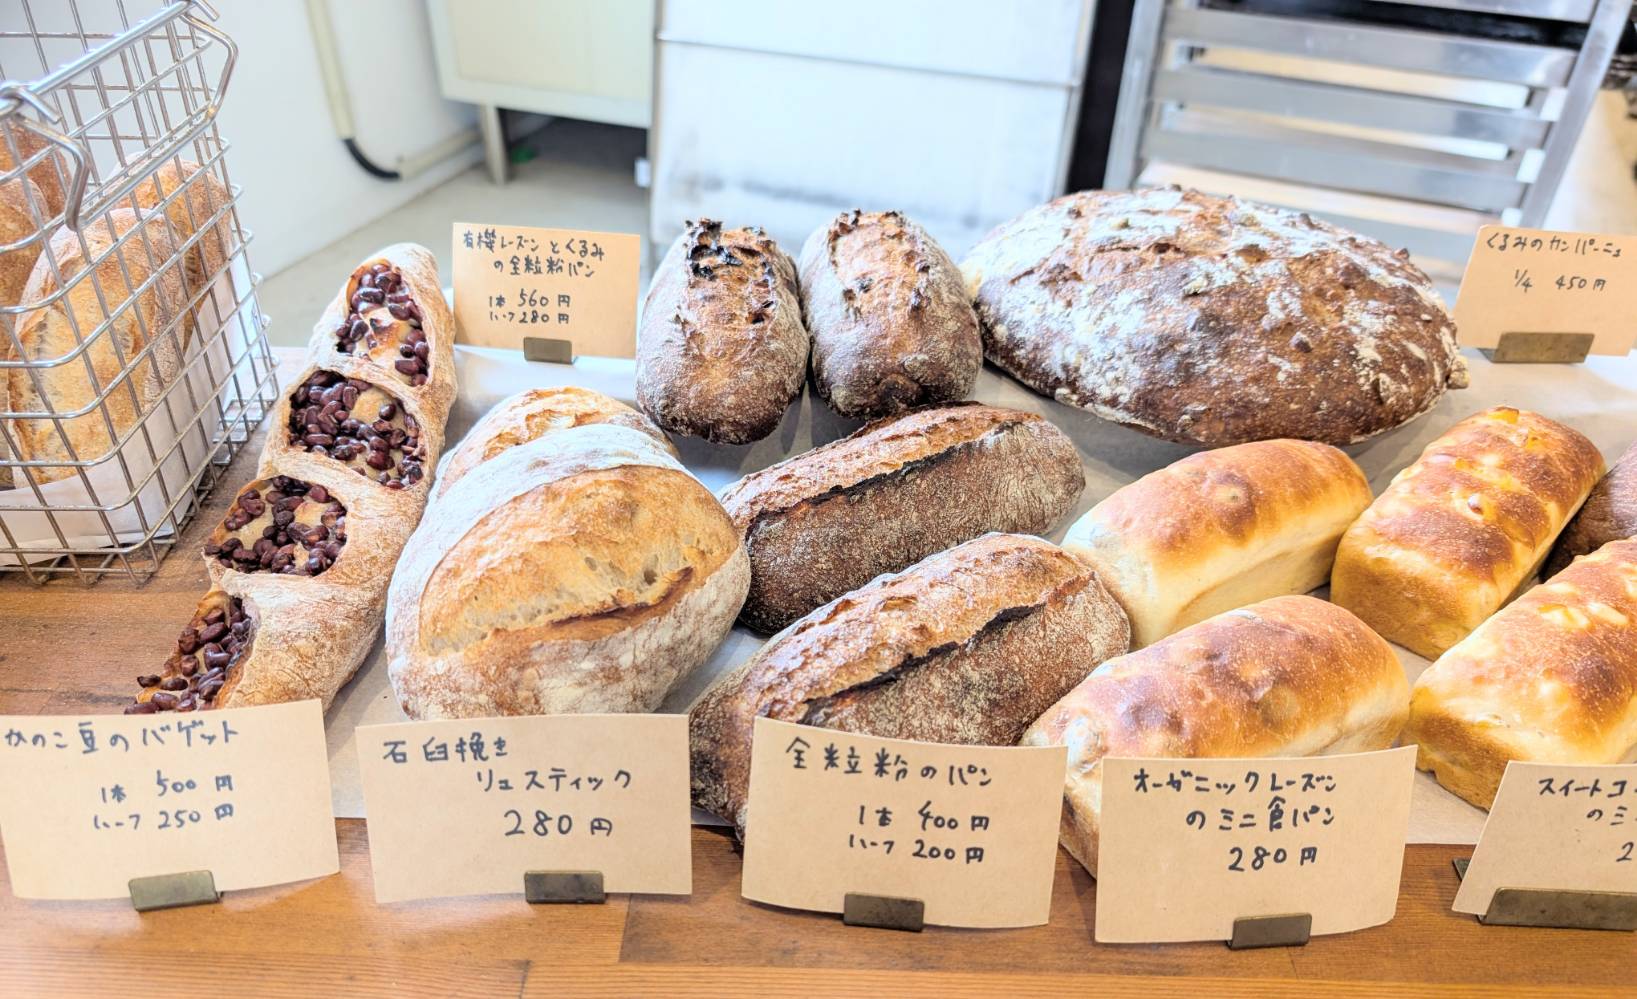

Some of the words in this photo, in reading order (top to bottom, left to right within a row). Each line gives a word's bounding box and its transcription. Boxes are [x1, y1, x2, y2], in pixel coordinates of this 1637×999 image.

[464, 228, 604, 261] 有機レーズンとくるみ
[494, 255, 595, 277] の全粒粉パン
[5, 720, 239, 754] かのこ豆のバゲット
[383, 731, 508, 763] 石臼挽き
[786, 736, 993, 787] 全粒粉のパン
[477, 767, 632, 792] リュスティック
[1133, 767, 1337, 794] オーガニックレーズン
[1538, 778, 1637, 798] スイートコ
[1186, 796, 1335, 831] のミニ食パン
[1586, 806, 1637, 825] のミ
